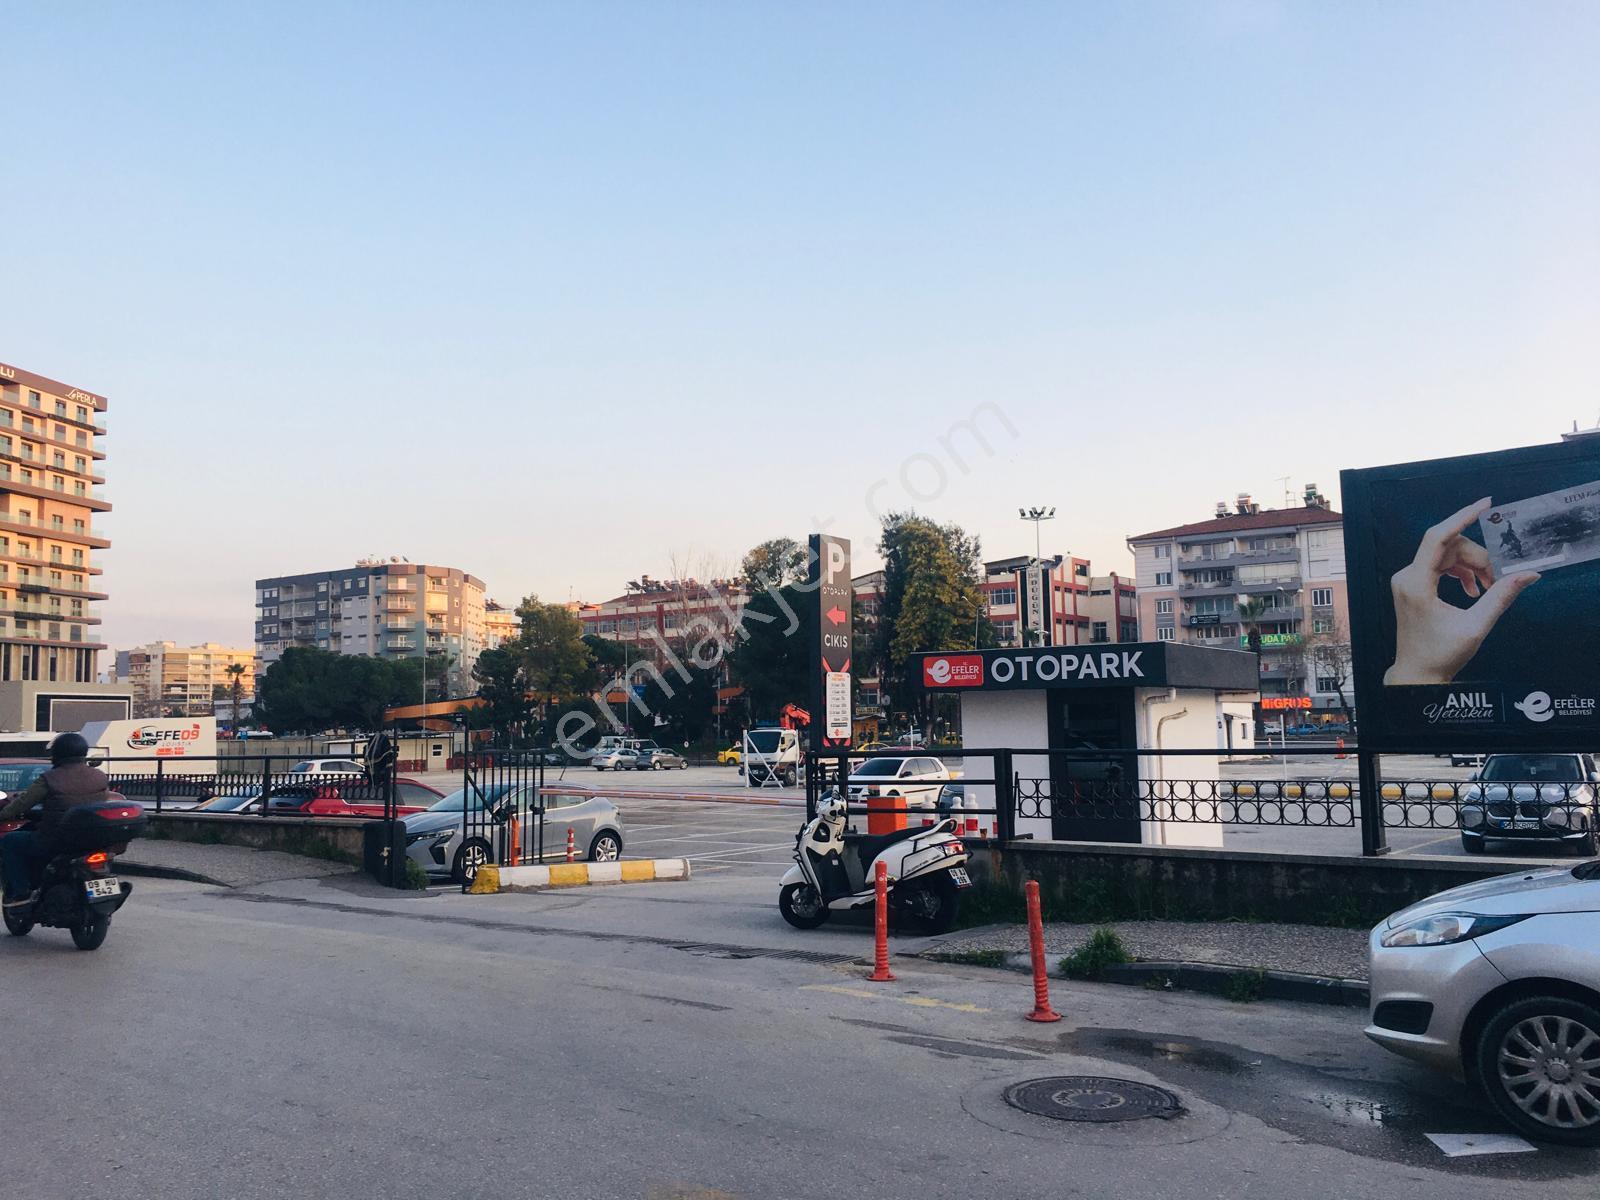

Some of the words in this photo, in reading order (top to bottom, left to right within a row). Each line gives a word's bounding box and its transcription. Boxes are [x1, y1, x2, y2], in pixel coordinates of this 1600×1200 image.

[76, 391, 97, 406] PERLA
[827, 542, 846, 585] P
[951, 665, 980, 675] EFELER
[991, 651, 1145, 683] OTOPARK
[1445, 691, 1494, 709] ANIL
[1554, 698, 1596, 709] EFELER
[155, 729, 200, 741] EFE09
